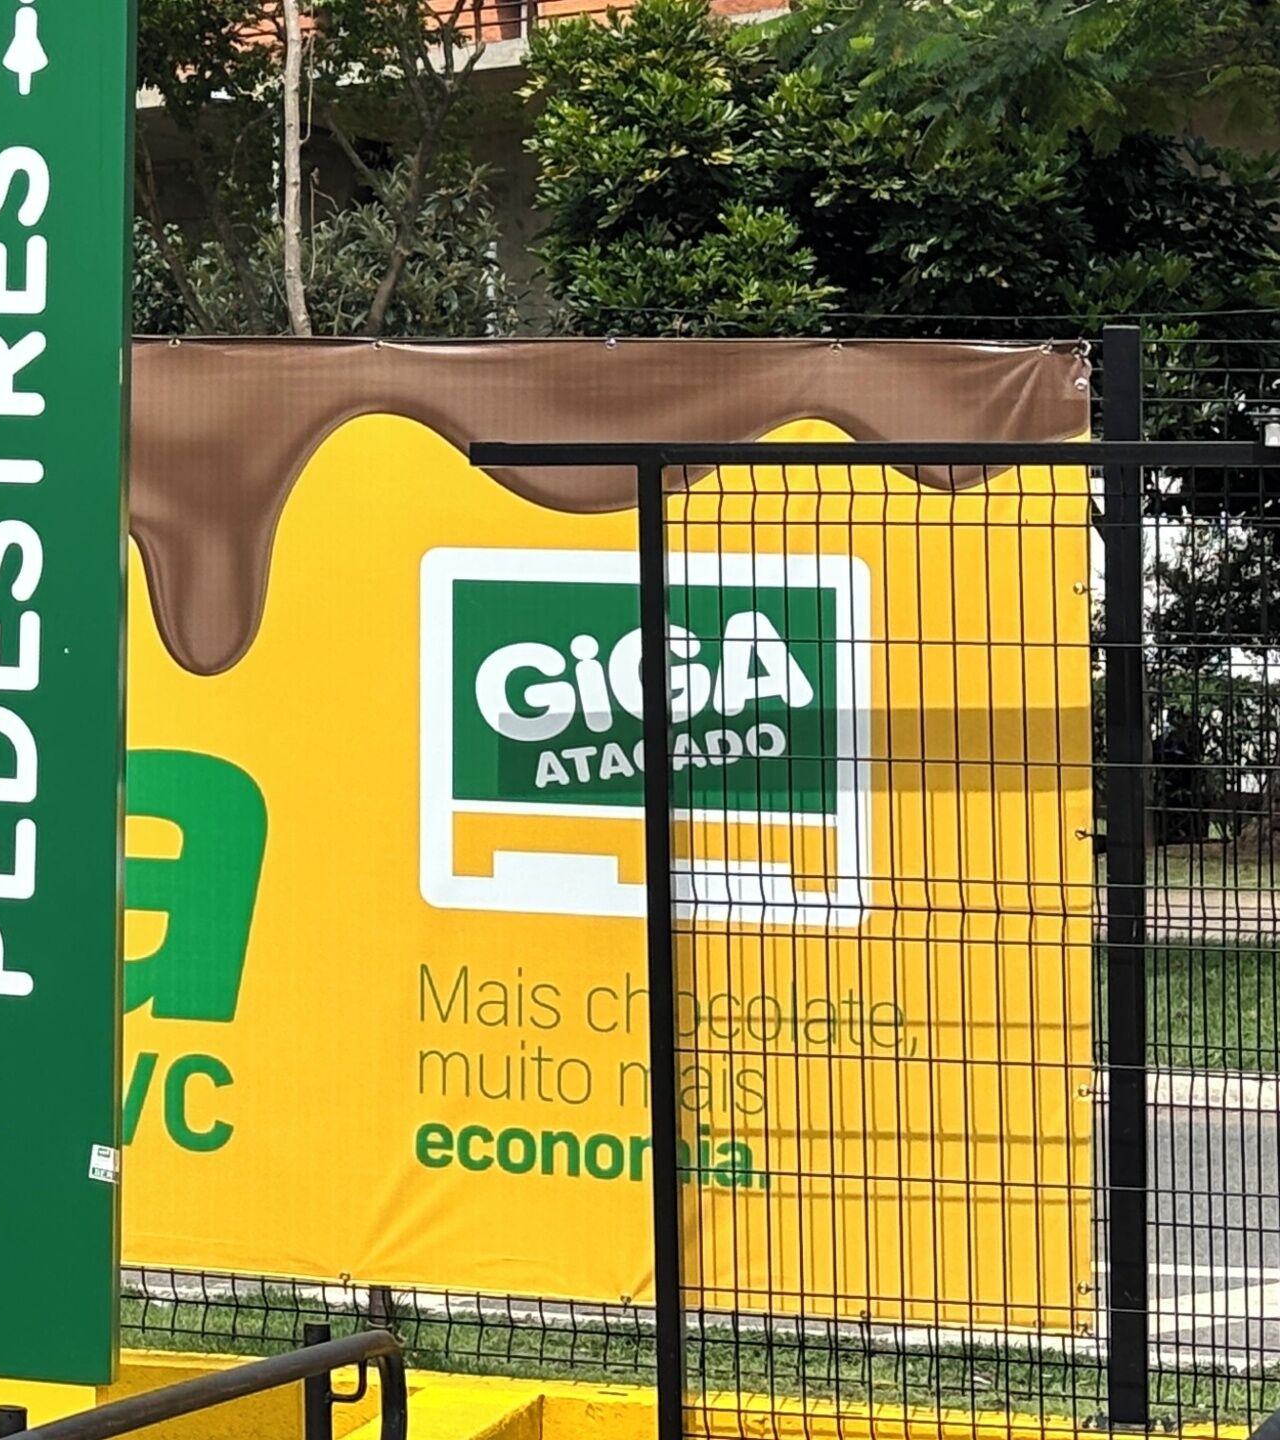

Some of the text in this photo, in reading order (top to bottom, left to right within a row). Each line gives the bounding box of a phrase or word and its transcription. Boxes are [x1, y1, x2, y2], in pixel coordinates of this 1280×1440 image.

[419, 962, 562, 1030] Mais
[418, 1040, 765, 1115] muito mais
